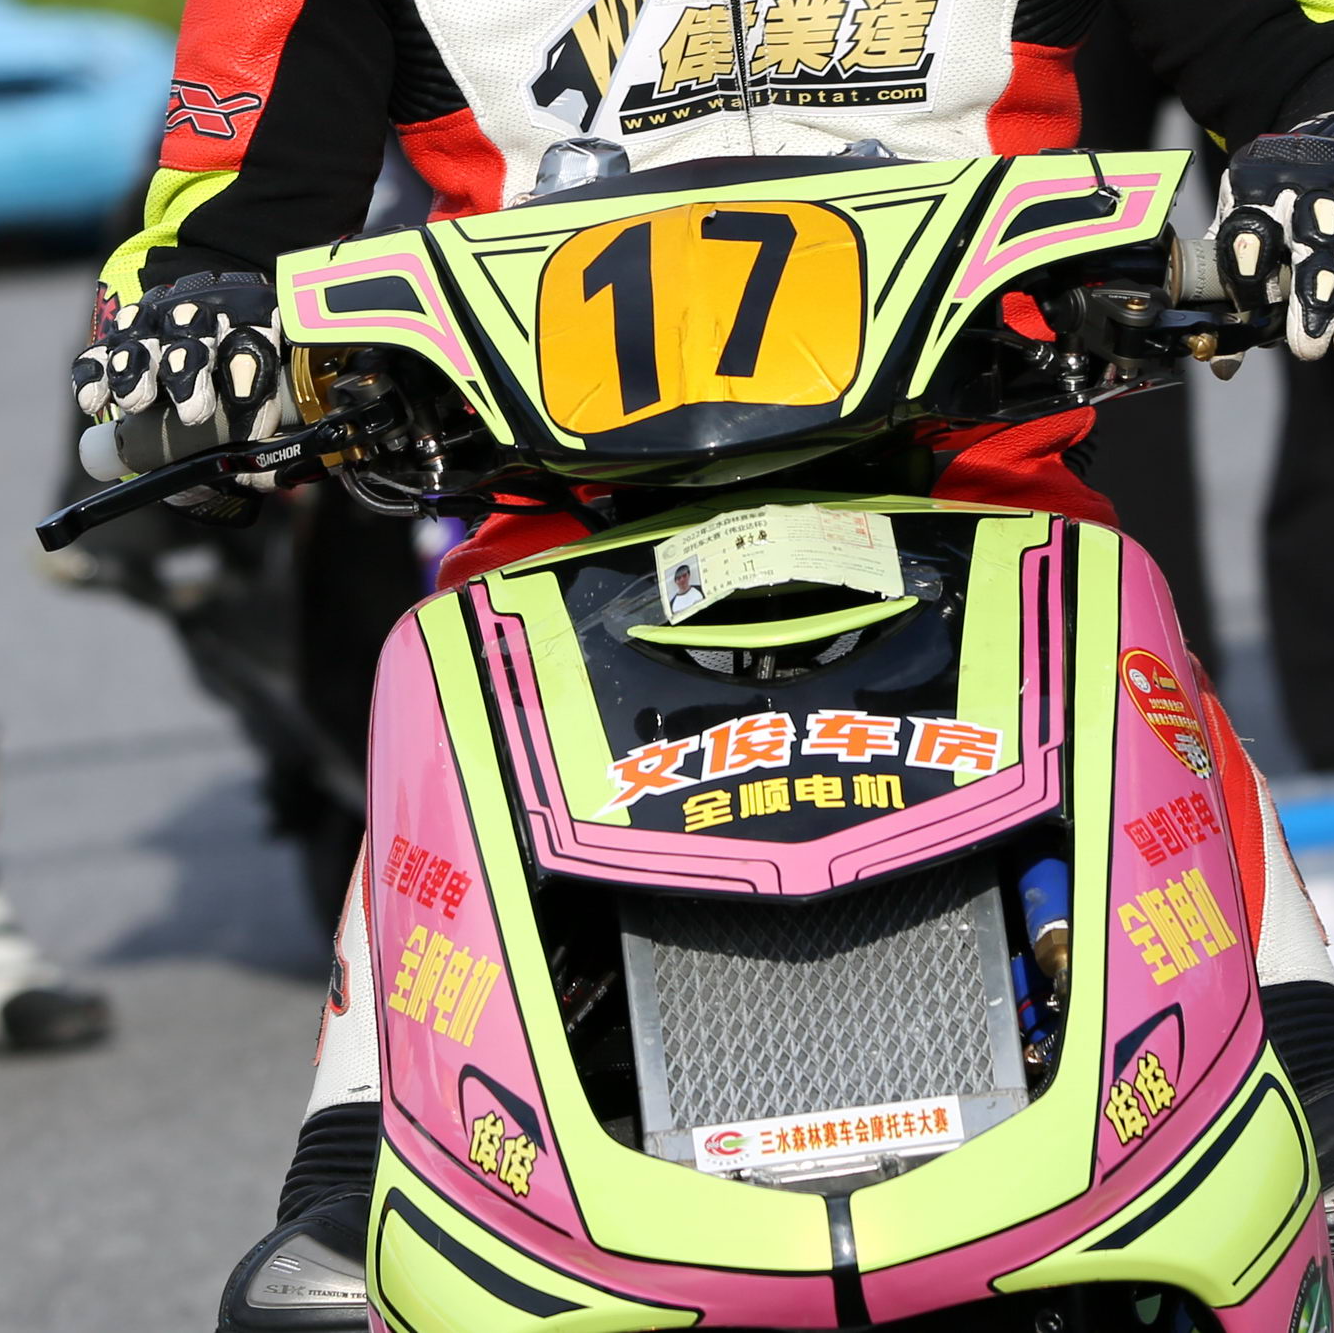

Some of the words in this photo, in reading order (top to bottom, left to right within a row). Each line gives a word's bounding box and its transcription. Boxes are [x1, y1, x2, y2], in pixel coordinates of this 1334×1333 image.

[624, 87, 926, 130] www.waiyiptat.com
[583, 210, 798, 416] 17
[256, 444, 301, 467] ANCHOR
[600, 710, 1003, 811] 文俊车房
[684, 773, 905, 832] 全顺电机
[1123, 791, 1221, 866] 粤凯锂电
[382, 834, 472, 921] 粤凯锂电
[1117, 867, 1238, 986] 全顺电机
[387, 924, 502, 1048] 全顺电机
[759, 1106, 949, 1155] 三水森林赛车会摩托车大赛
[1104, 1050, 1176, 1146] 俊俊
[469, 1111, 538, 1198] 俊俊
